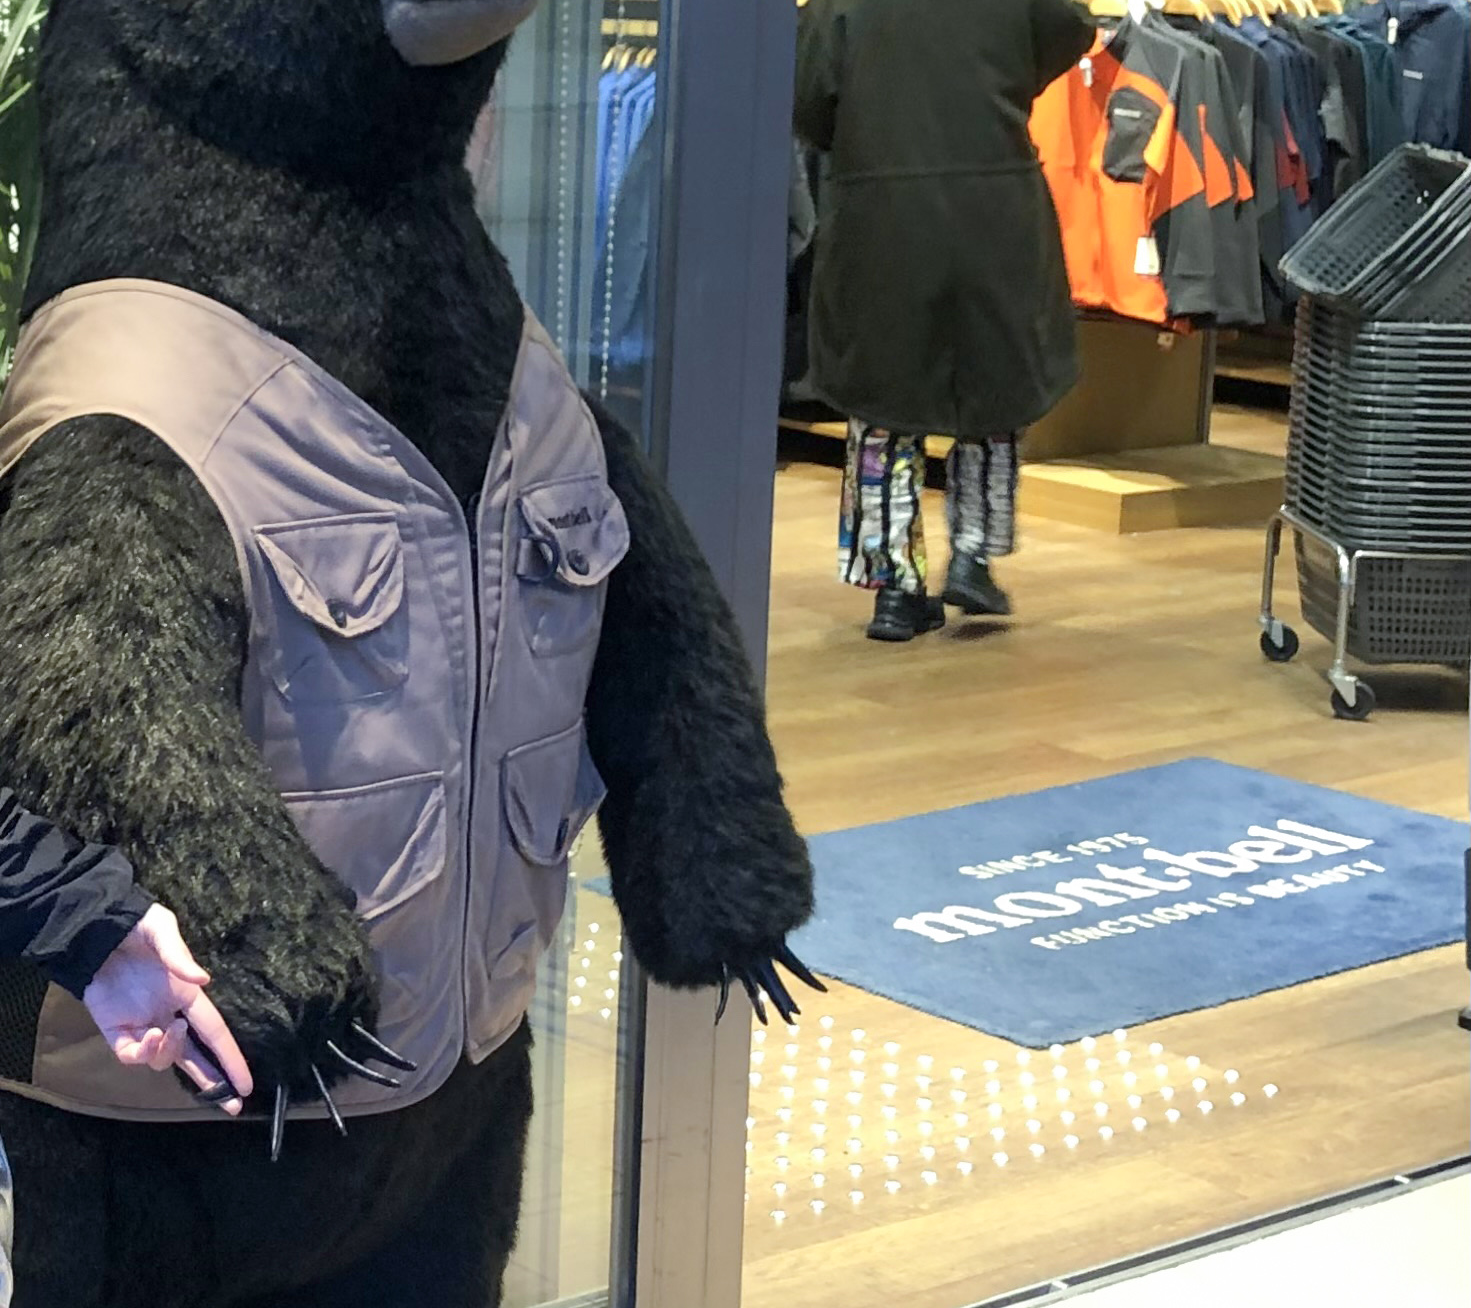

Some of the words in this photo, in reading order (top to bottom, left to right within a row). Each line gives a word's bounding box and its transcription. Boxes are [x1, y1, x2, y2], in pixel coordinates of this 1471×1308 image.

[958, 849, 1074, 879] SINCE
[1066, 832, 1150, 856] 1975
[1030, 900, 1218, 950] FUNCTION
[1207, 891, 1256, 908] IS
[1246, 859, 1386, 899] BEAUTY
